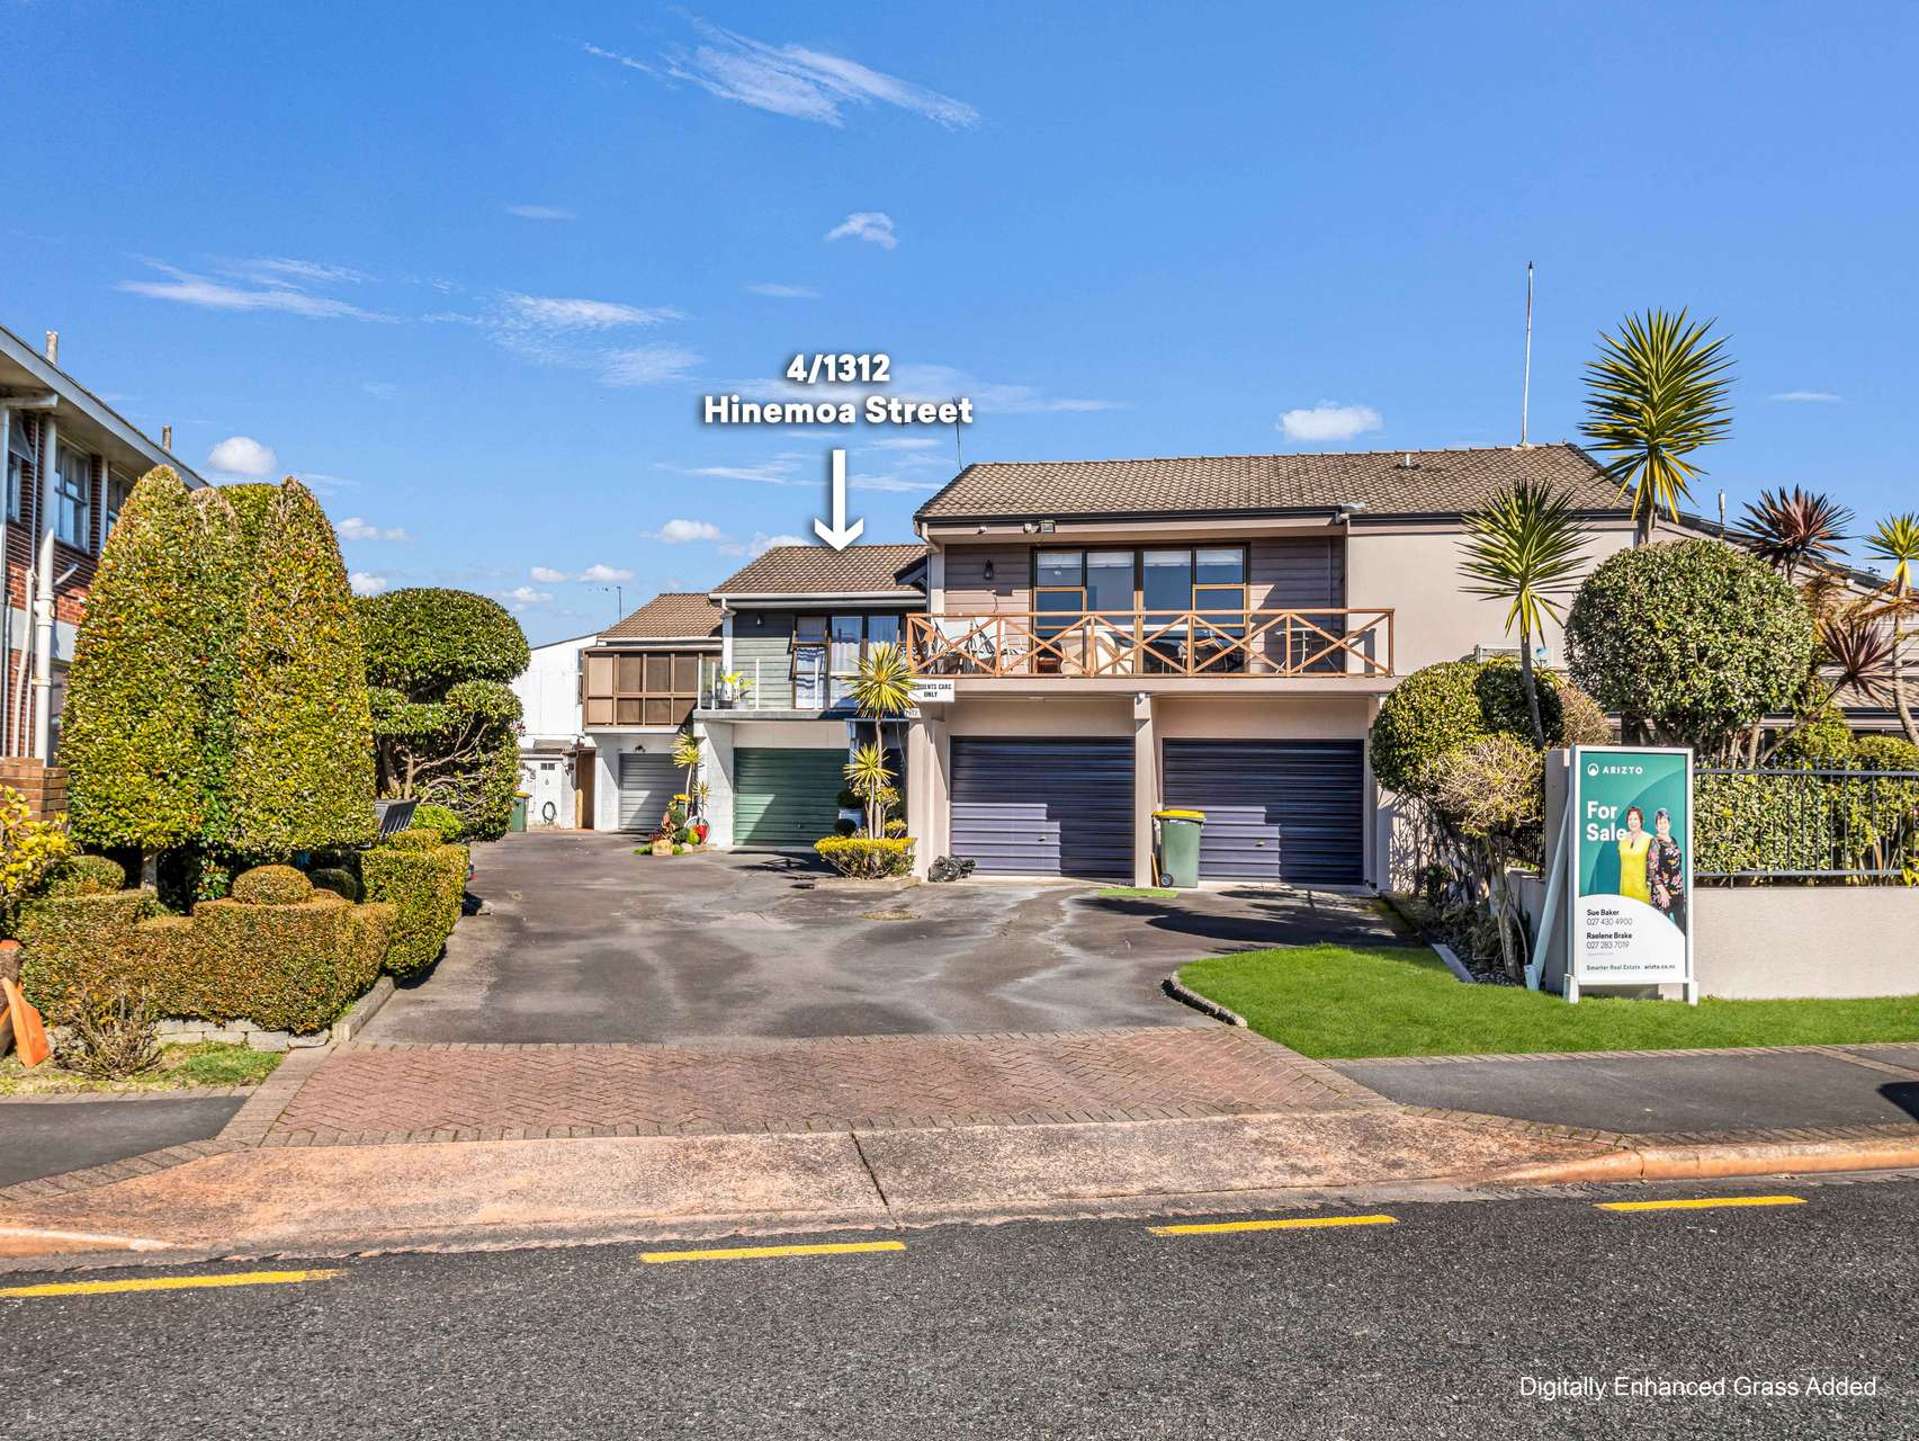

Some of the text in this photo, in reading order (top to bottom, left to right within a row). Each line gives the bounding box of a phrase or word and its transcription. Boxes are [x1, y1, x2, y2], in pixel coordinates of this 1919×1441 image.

[1602, 765, 1643, 775] ARIZTO
[1587, 800, 1618, 819] For
[1586, 822, 1627, 842] Sale
[1586, 918, 1599, 926] 027
[1586, 941, 1598, 949] 027
